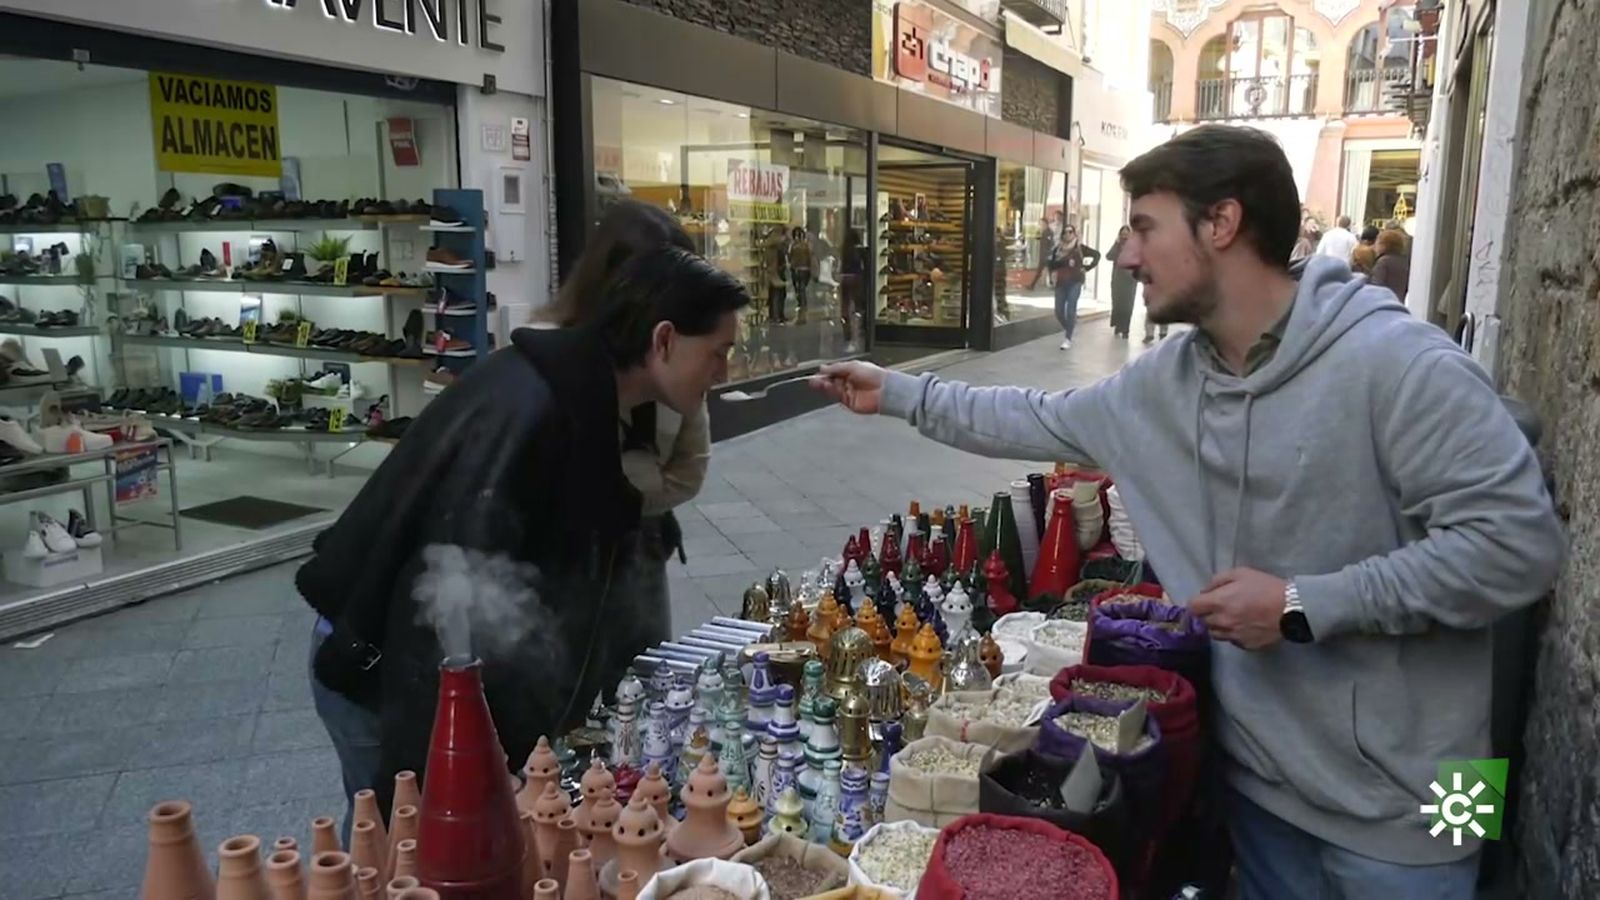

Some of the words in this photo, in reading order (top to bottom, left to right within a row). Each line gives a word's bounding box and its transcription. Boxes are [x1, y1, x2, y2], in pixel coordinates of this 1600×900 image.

[158, 75, 272, 113] VACIAMOS
[161, 115, 277, 160] ALMACEN
[733, 166, 784, 200] REBAJAS
